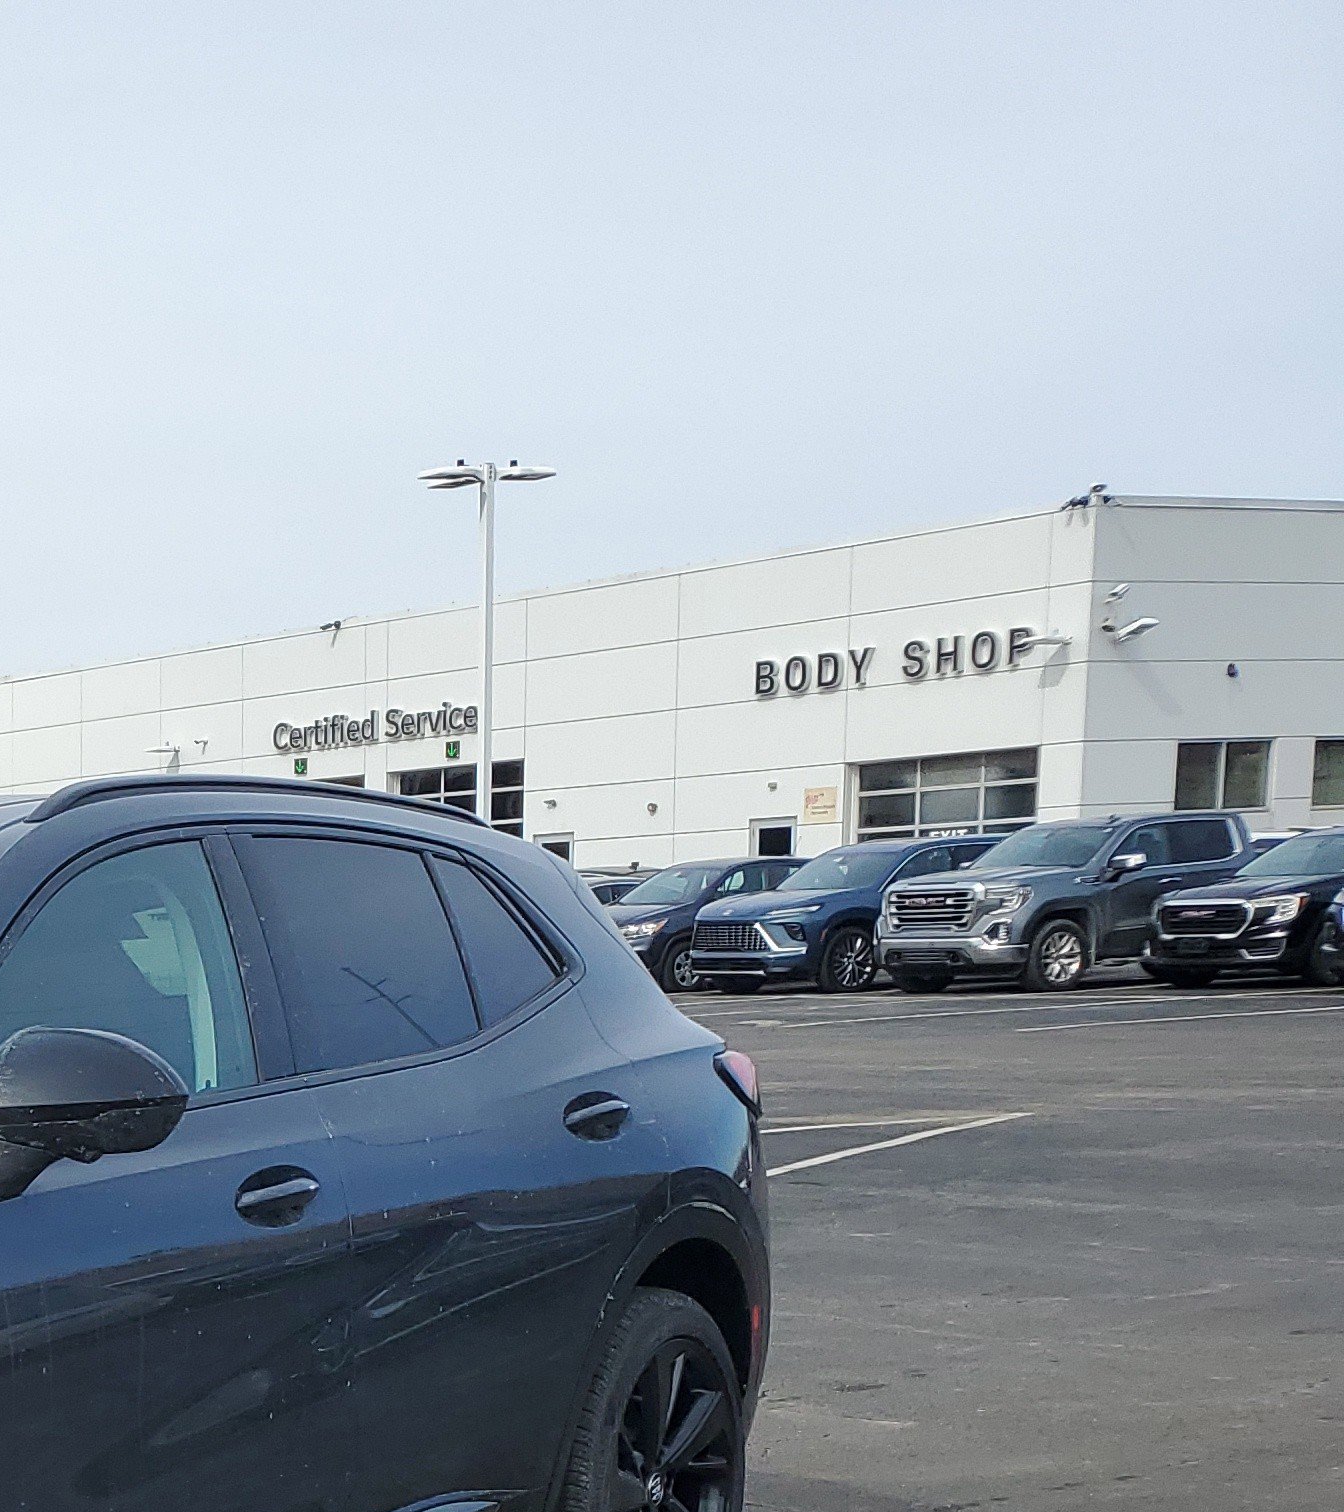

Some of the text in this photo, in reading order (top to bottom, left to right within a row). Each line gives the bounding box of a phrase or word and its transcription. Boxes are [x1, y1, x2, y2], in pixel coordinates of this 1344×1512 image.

[754, 626, 1035, 696] BODY SHOP
[272, 701, 479, 752] Certified Service
